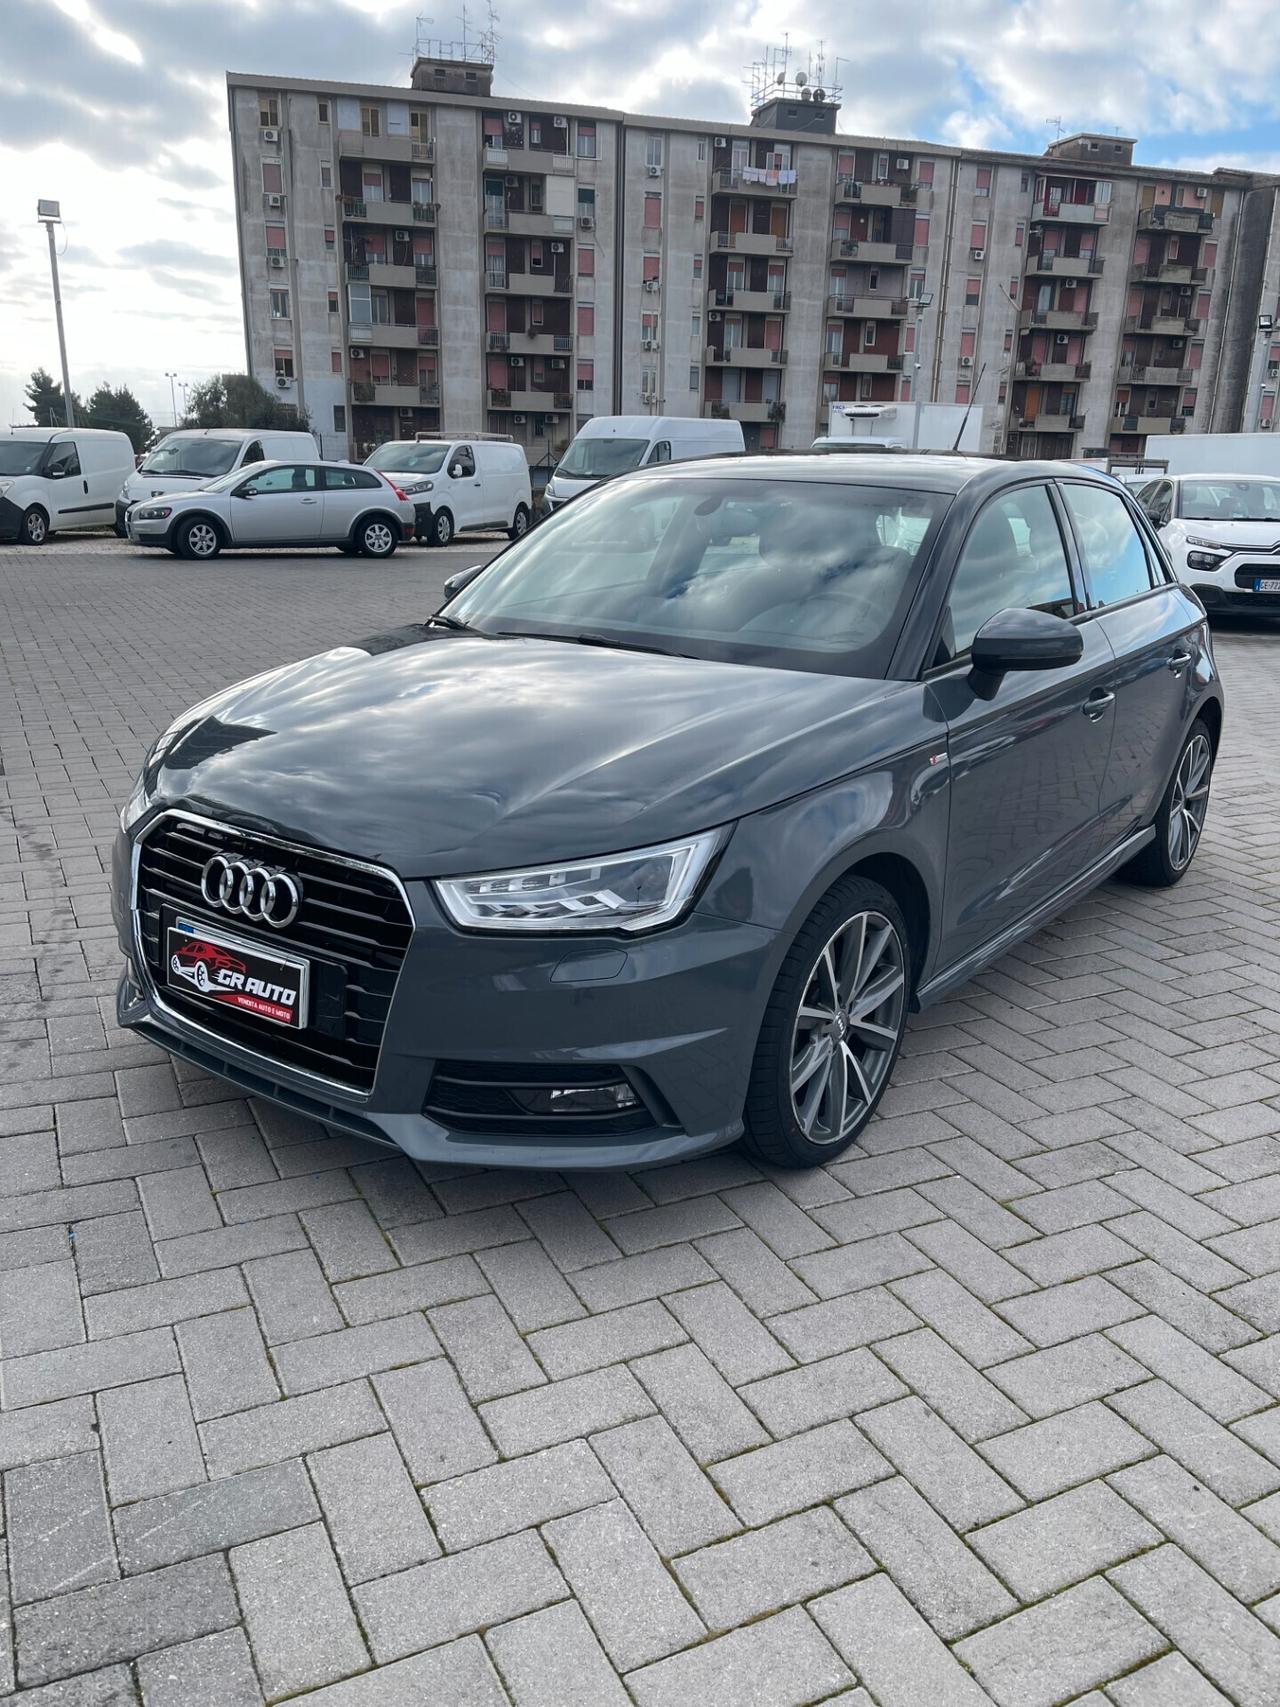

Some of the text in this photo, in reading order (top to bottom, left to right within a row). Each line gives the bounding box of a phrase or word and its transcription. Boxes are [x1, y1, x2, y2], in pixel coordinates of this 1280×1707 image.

[217, 969, 297, 1006] GR AUTO
[237, 997, 257, 1008] VENDITA
[258, 1004, 271, 1013] AUTO
[275, 1010, 290, 1019] MOTO
